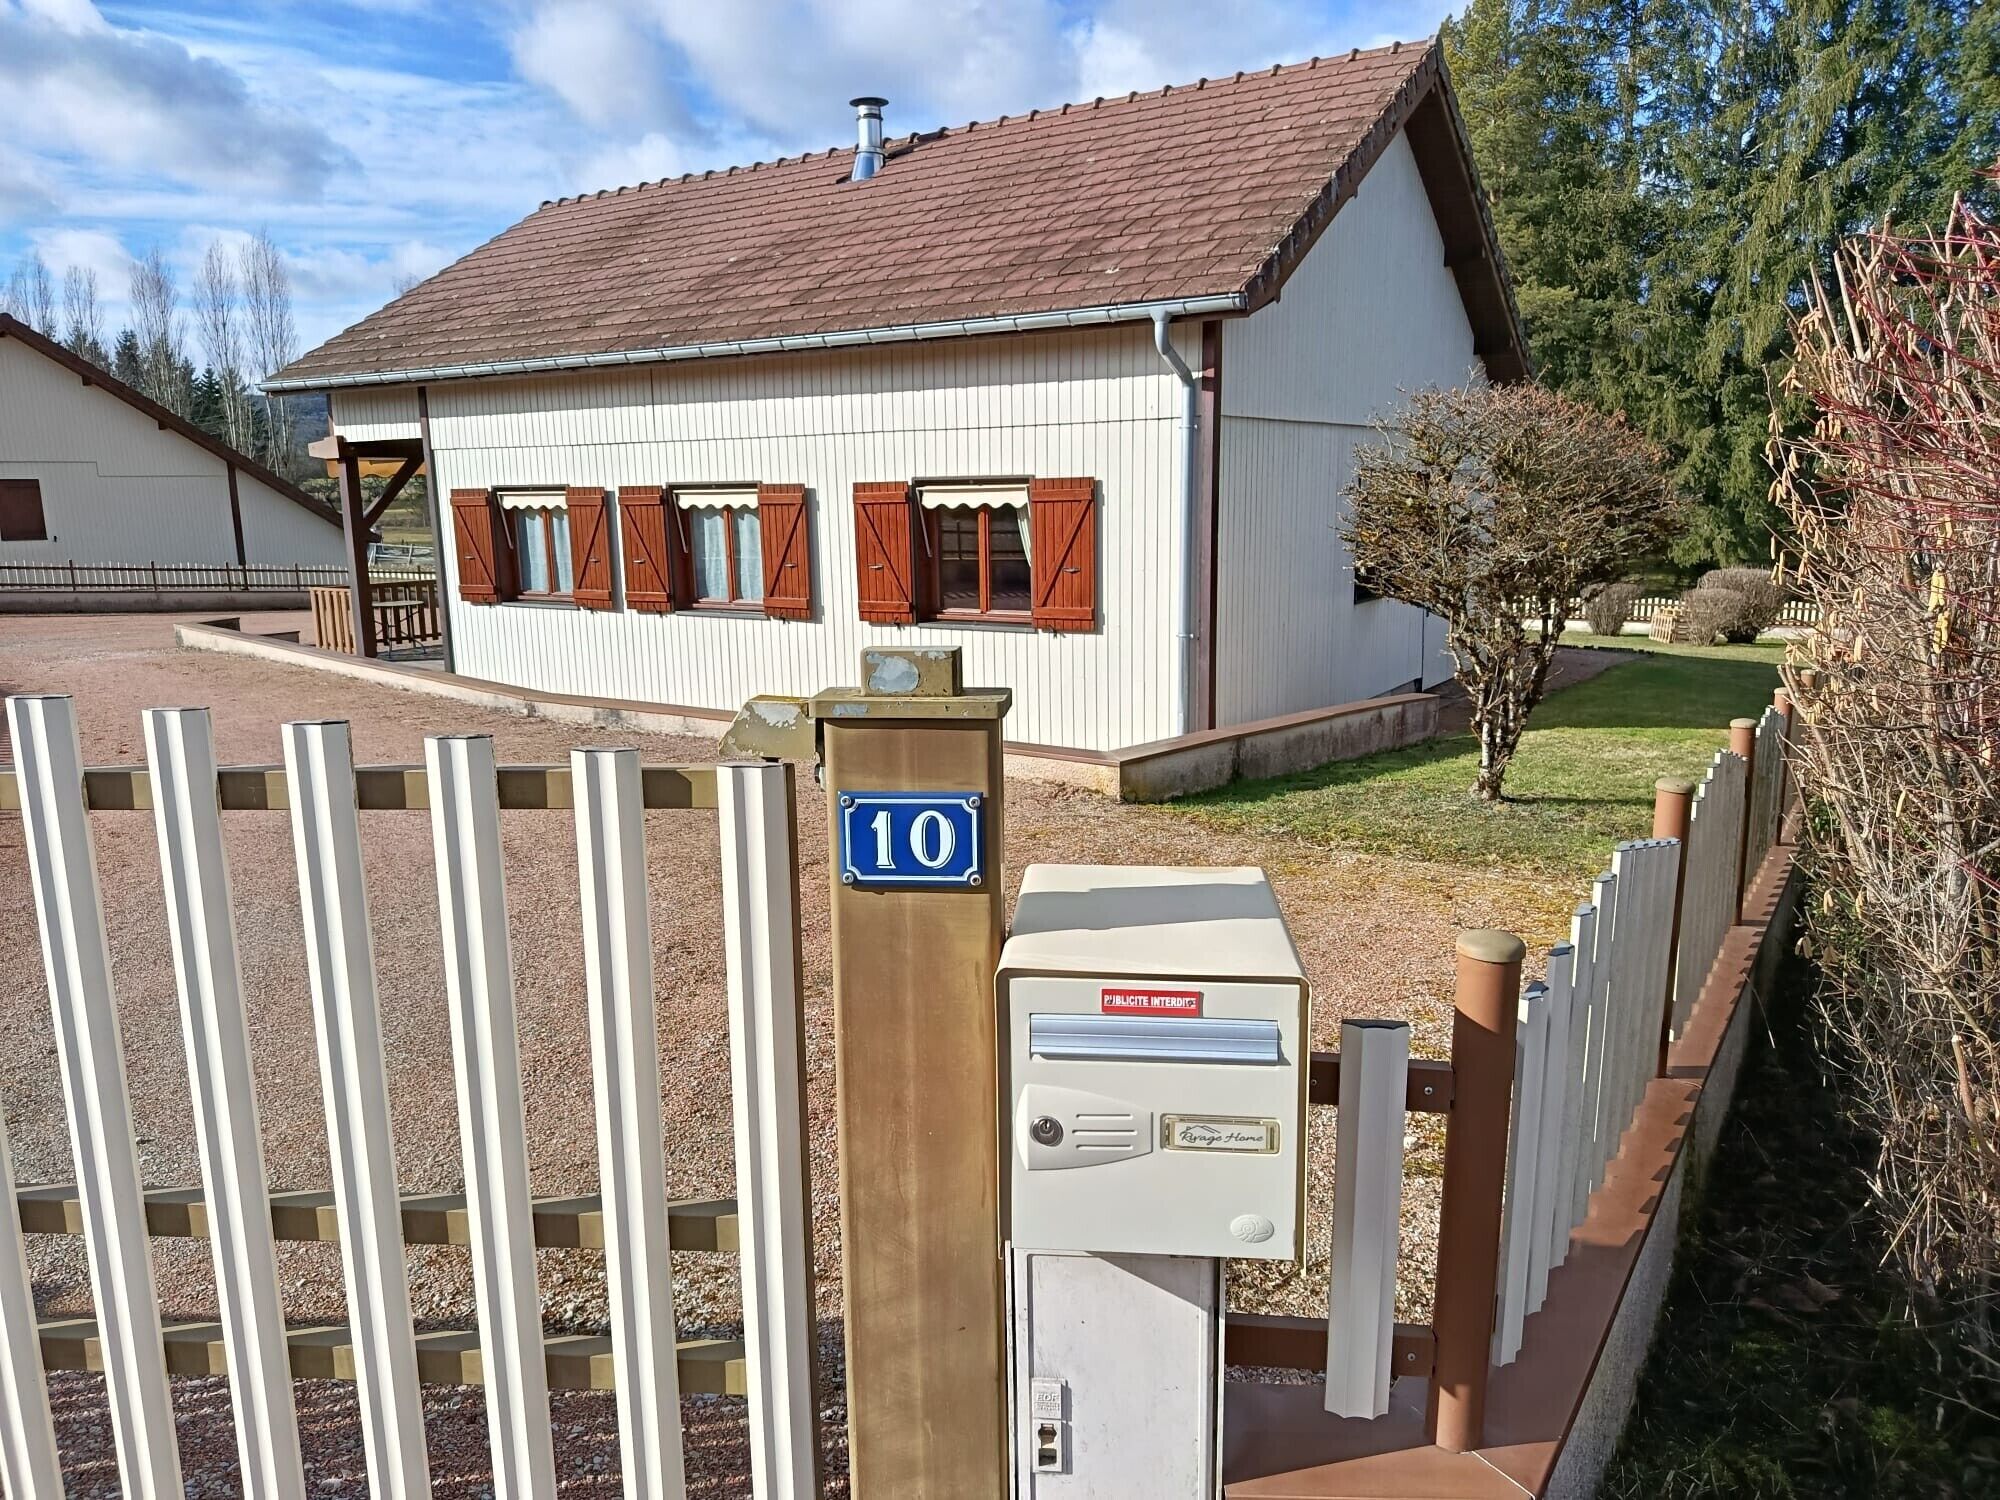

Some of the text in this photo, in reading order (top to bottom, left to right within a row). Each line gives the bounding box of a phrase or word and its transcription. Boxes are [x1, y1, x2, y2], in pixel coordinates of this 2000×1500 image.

[870, 810, 956, 869] 10
[1103, 994, 1149, 1006] PUBLICITE
[1223, 1132, 1265, 1143] Home
